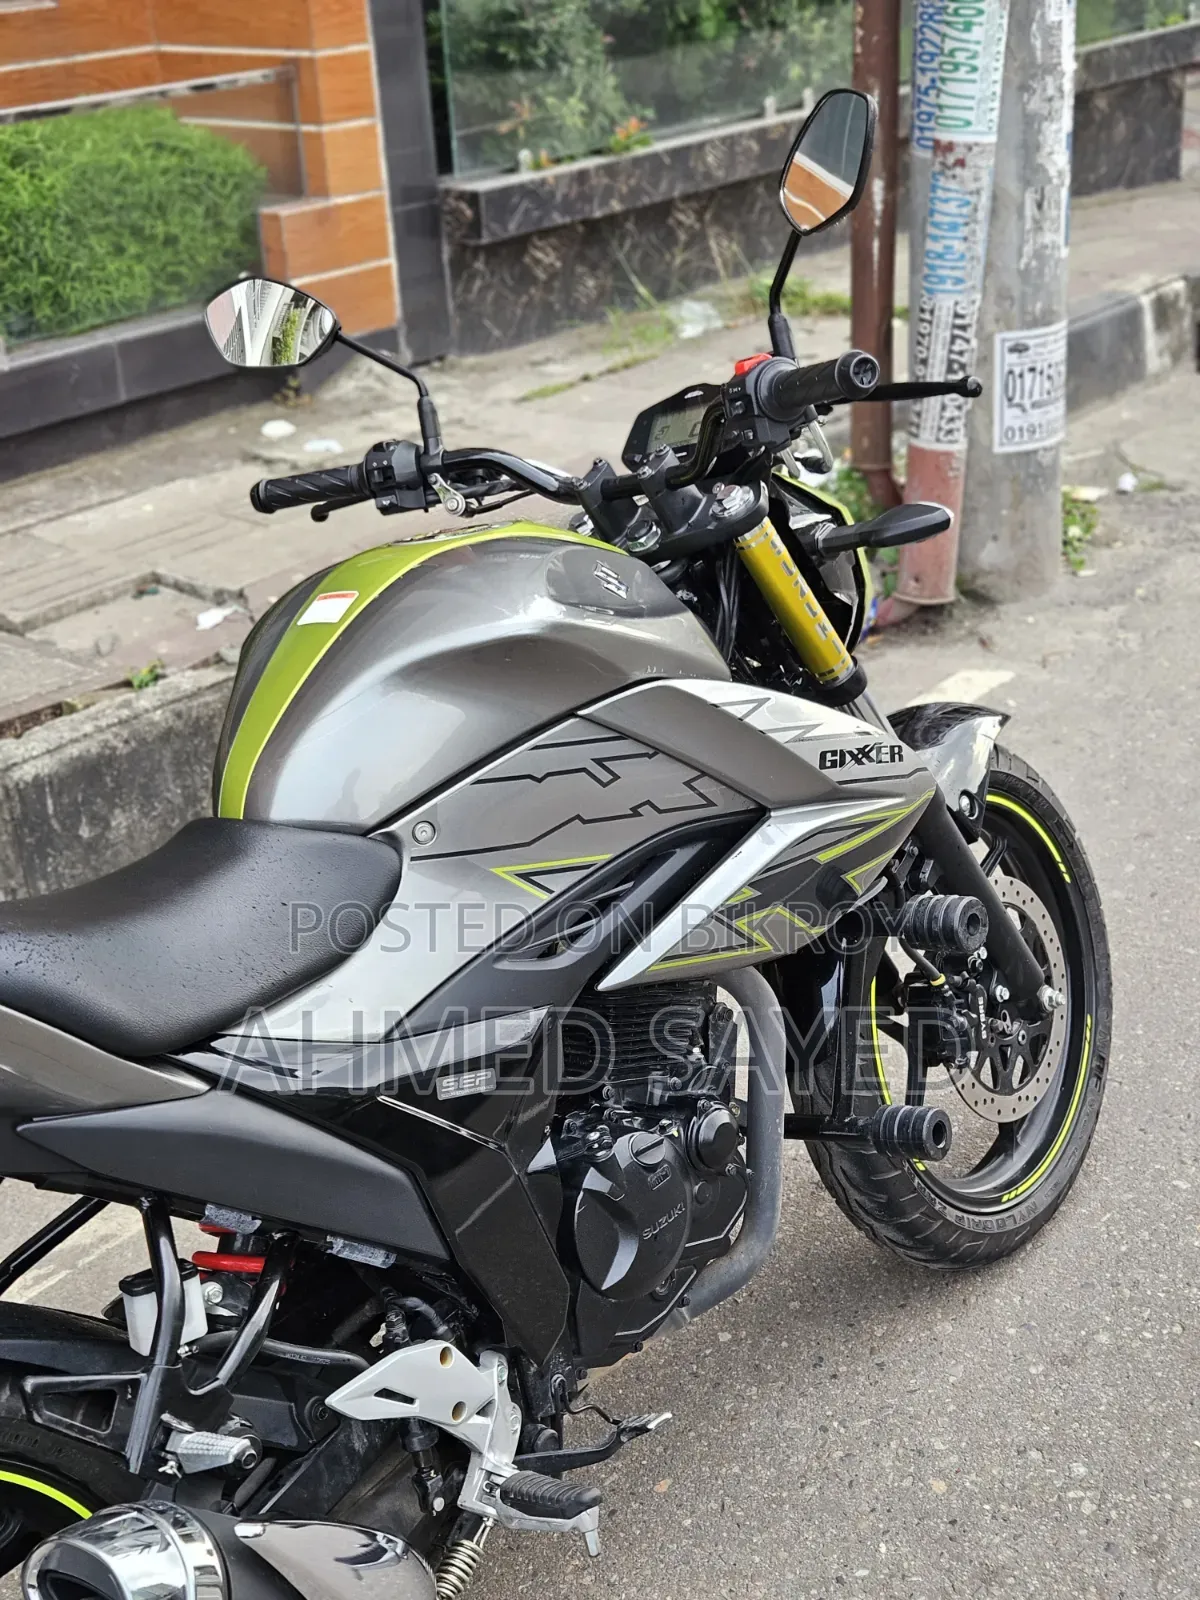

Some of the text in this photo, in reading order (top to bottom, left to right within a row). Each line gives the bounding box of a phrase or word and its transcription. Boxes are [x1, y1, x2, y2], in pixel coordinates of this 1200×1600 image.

[819, 742, 904, 770] GIXXER
[441, 1071, 492, 1092] SEP
[643, 1202, 685, 1240] SUZUKI
